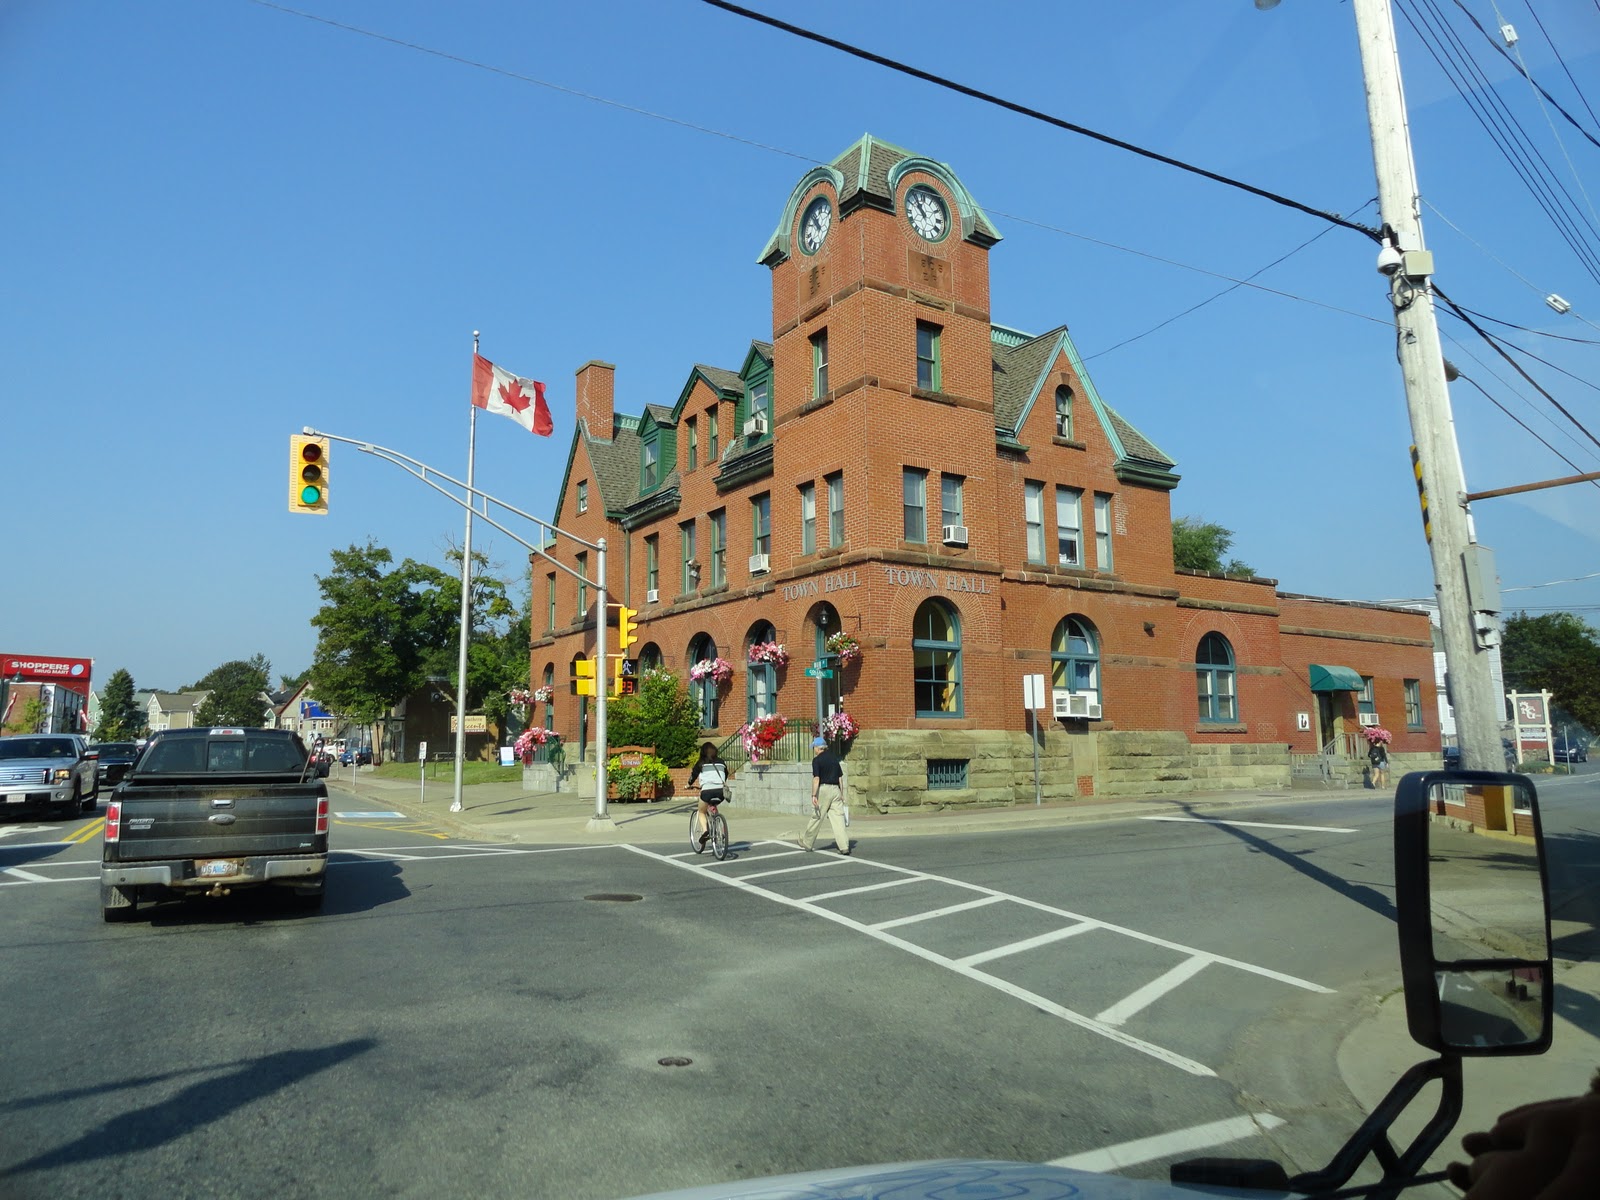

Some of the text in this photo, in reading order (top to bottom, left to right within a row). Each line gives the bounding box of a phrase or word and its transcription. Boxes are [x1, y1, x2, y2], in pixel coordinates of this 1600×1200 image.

[782, 571, 861, 602] TOWN HALL
[884, 566, 991, 594] TOWN HALL
[11, 661, 70, 670] SHOPPERS
